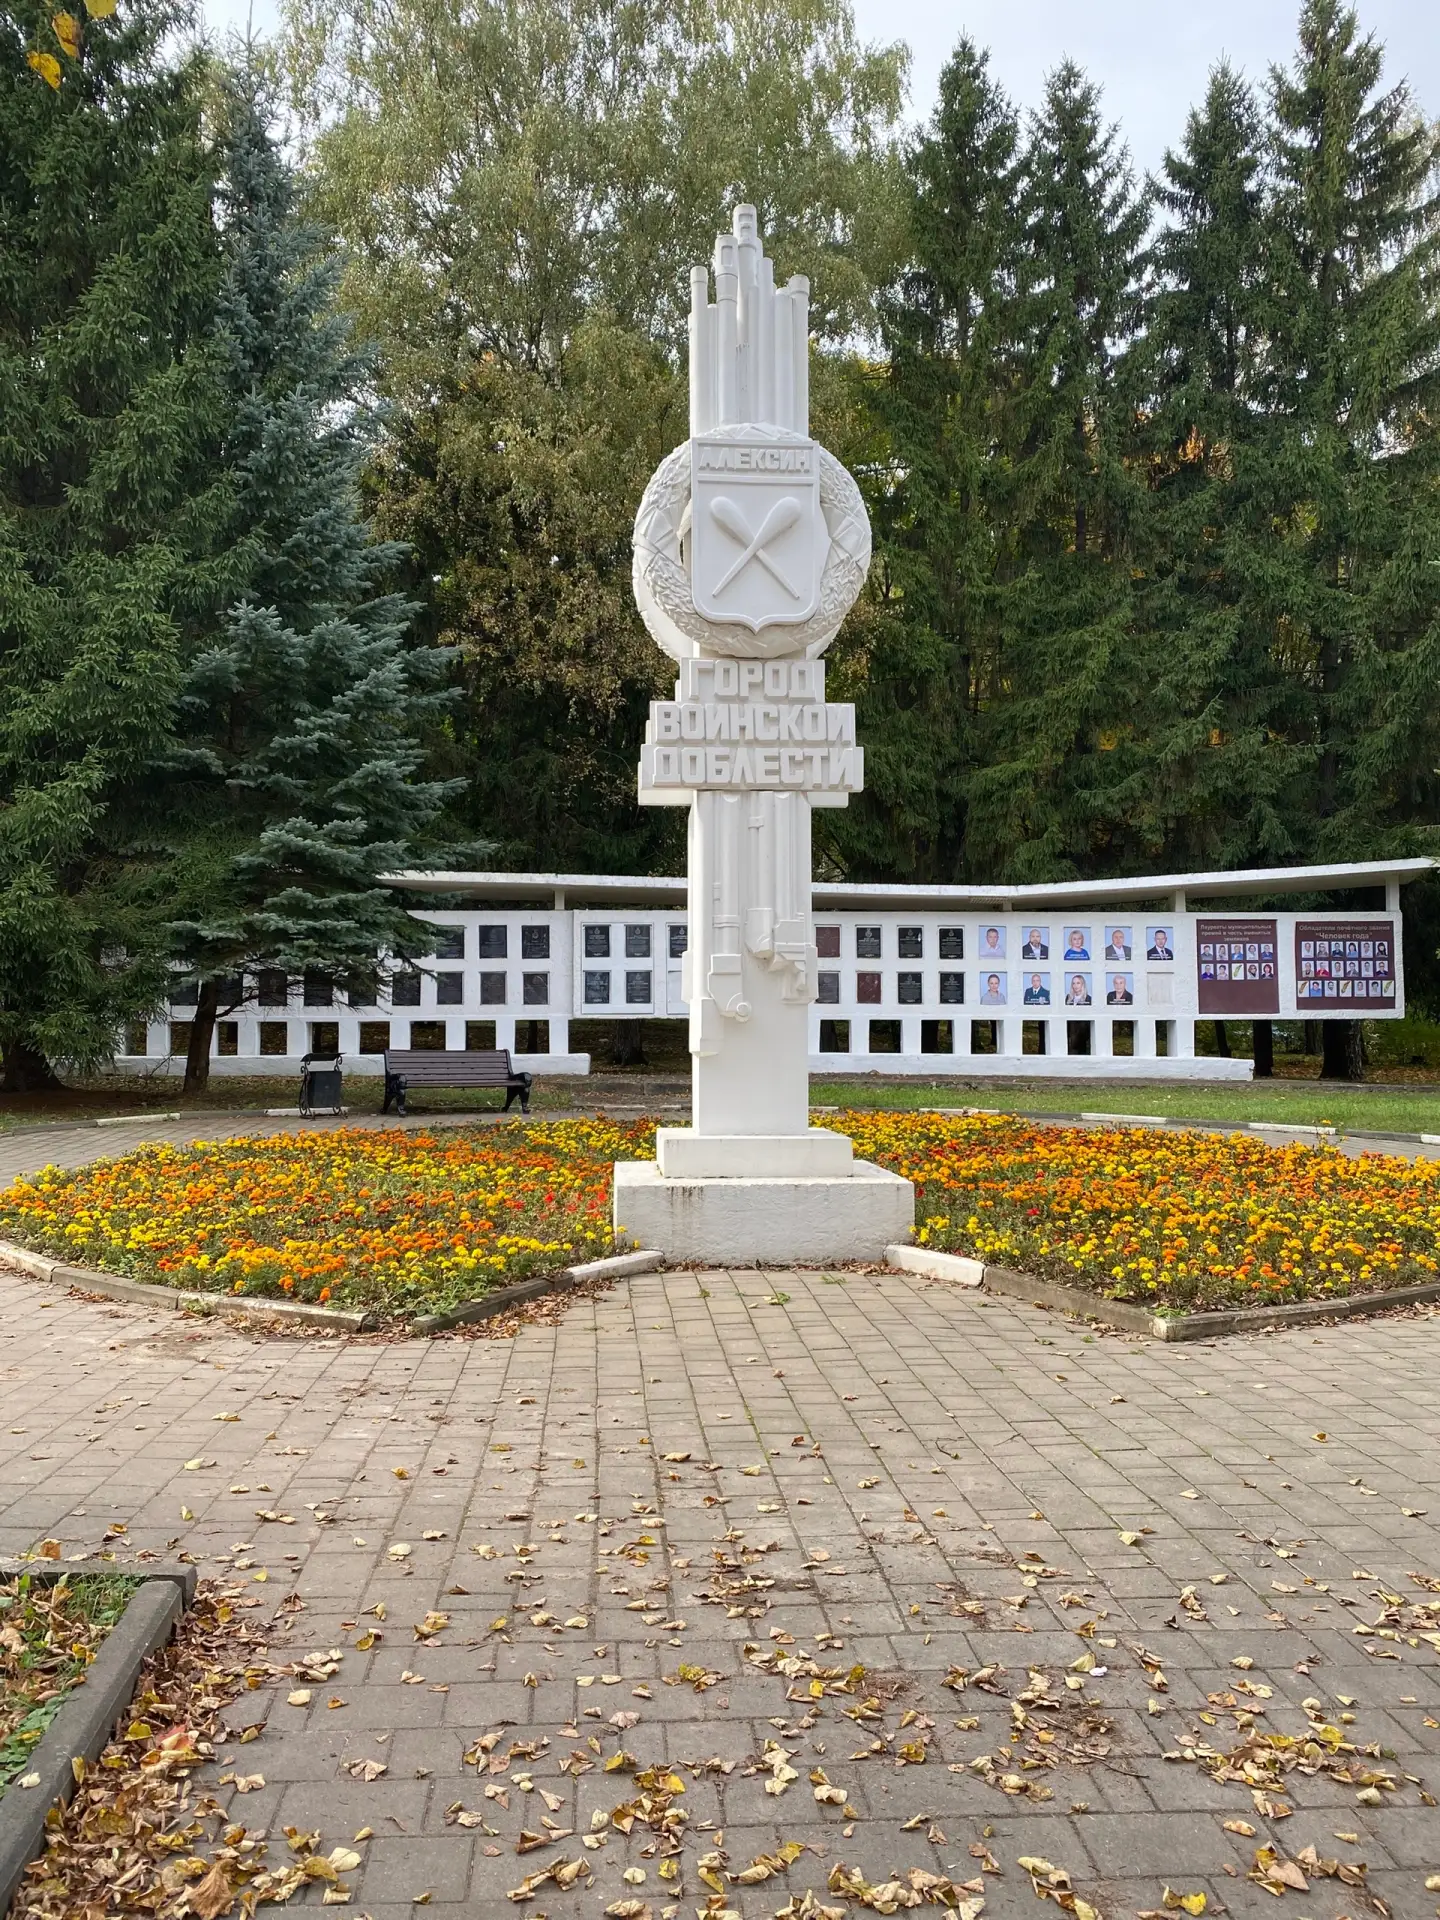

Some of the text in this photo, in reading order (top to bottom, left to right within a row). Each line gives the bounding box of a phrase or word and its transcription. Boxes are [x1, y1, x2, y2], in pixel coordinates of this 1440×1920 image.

[699, 447, 810, 473] АЛЕКСИН
[689, 660, 816, 700] ГОРОД
[653, 747, 853, 788] ДОБЛЕСТИ
